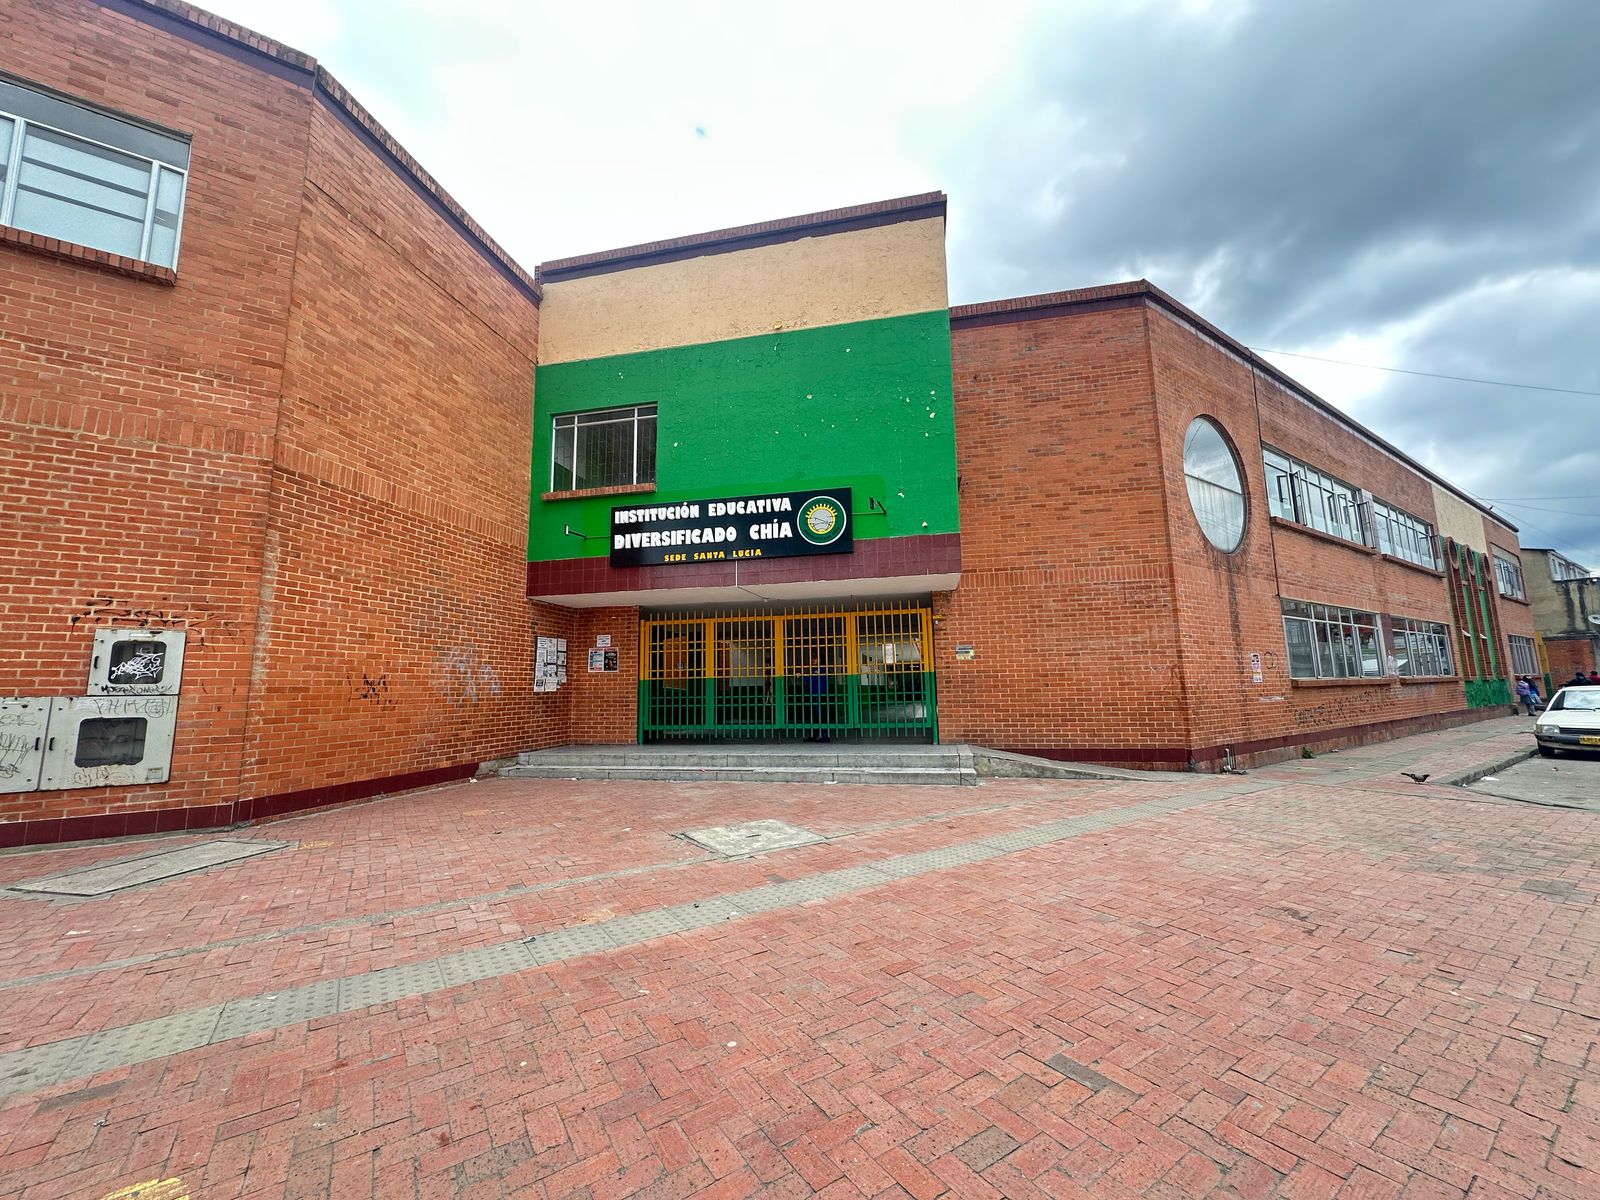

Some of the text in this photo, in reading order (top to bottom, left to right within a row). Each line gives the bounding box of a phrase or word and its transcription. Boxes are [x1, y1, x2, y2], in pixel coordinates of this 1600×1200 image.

[614, 497, 793, 524] INSTITUCIÓN EDUCATIVA
[614, 527, 737, 550] DIVERSIFICADO
[749, 518, 793, 540] CHÍA
[664, 548, 762, 562] SEDE SANTA LUCIA
